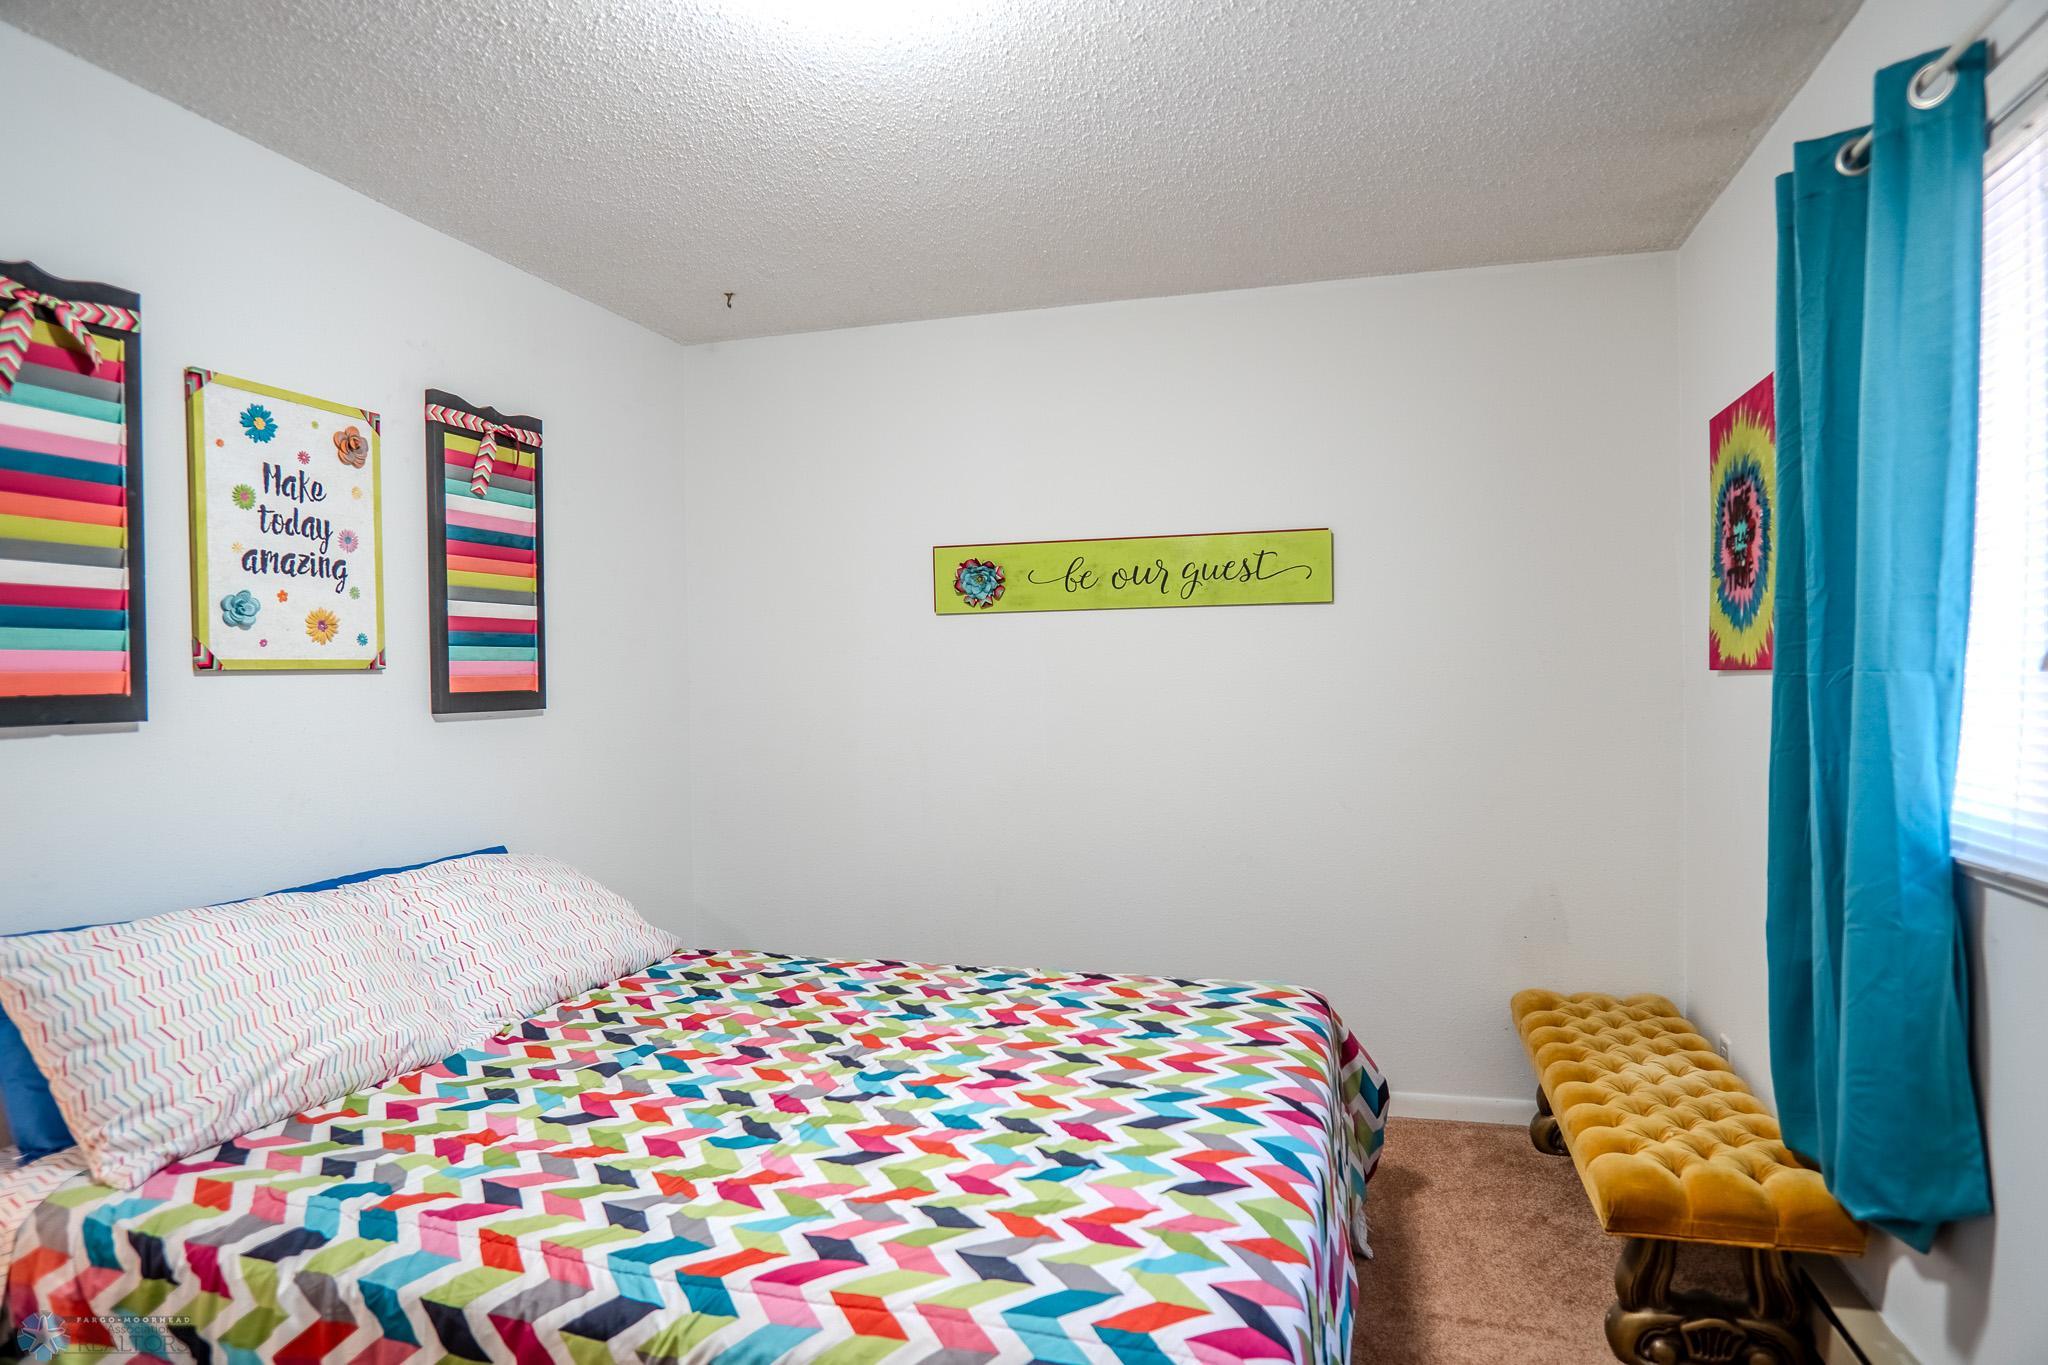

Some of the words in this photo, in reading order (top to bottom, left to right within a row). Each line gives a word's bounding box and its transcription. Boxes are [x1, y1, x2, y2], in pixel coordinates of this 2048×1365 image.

[262, 462, 327, 504] Make
[257, 504, 333, 554] today
[241, 548, 349, 594] amazing
[1028, 556, 1098, 593] be
[1111, 559, 1169, 594] our
[1181, 549, 1312, 600] guest
